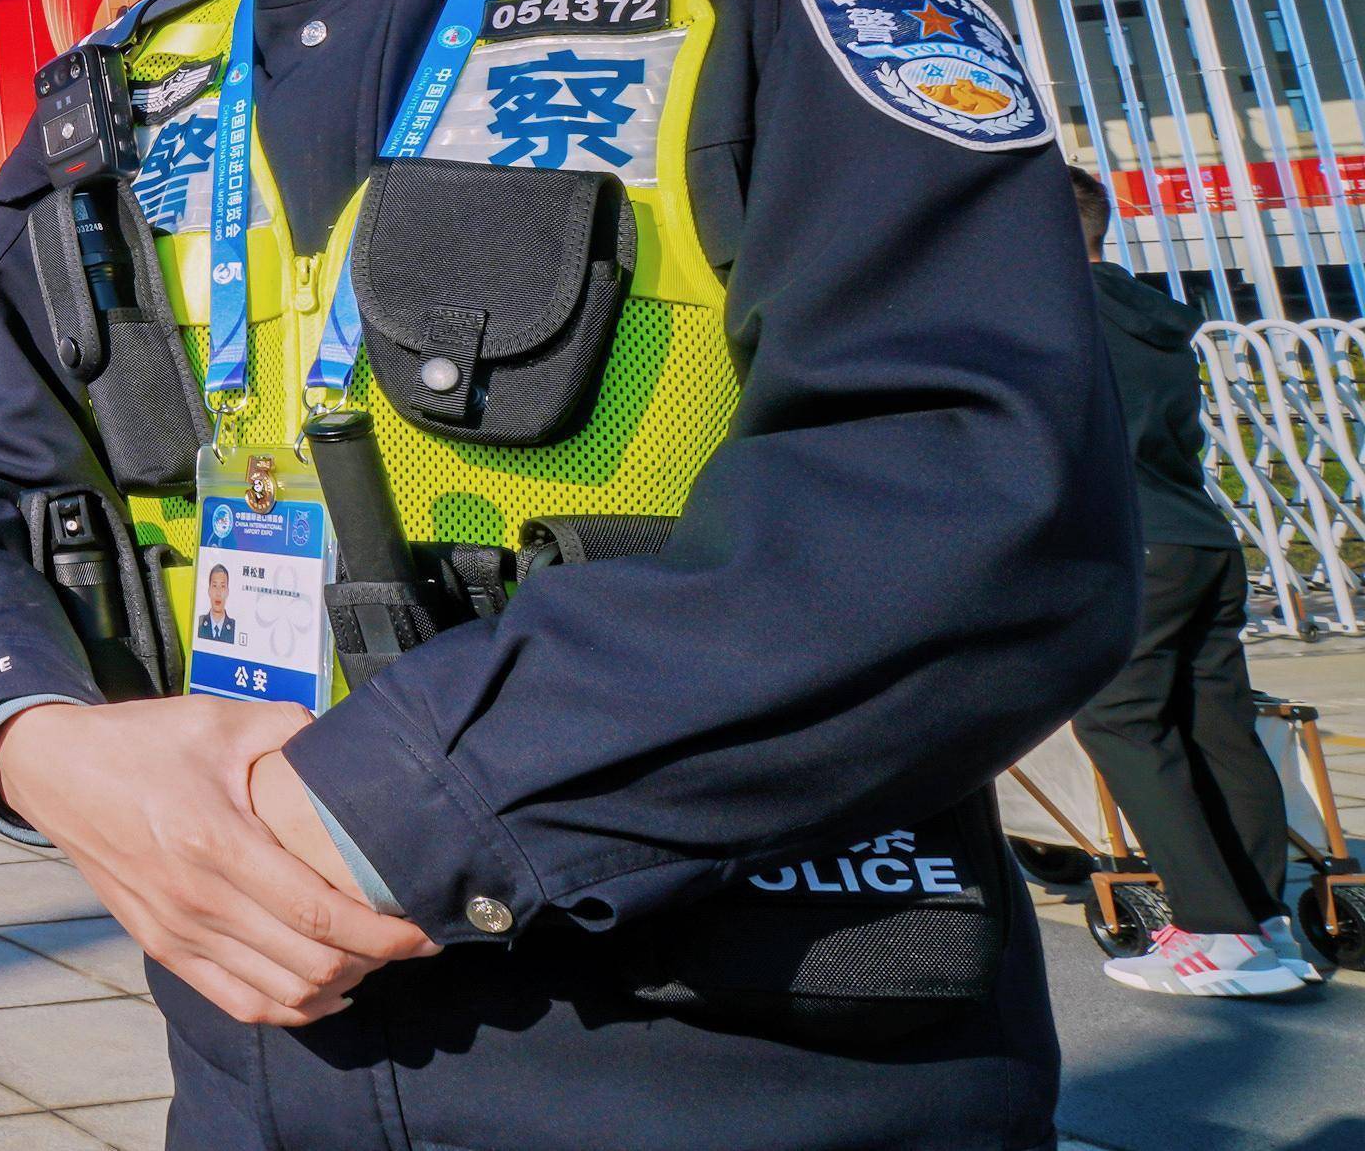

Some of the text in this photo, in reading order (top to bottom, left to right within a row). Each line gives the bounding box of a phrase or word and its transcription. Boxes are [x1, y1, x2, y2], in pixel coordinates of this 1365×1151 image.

[904, 44, 996, 65] POLICE
[486, 50, 645, 169] 察
[225, 99, 246, 238] 中国国际进口博览会
[234, 666, 268, 692] 公安
[747, 857, 963, 893] OLICE
